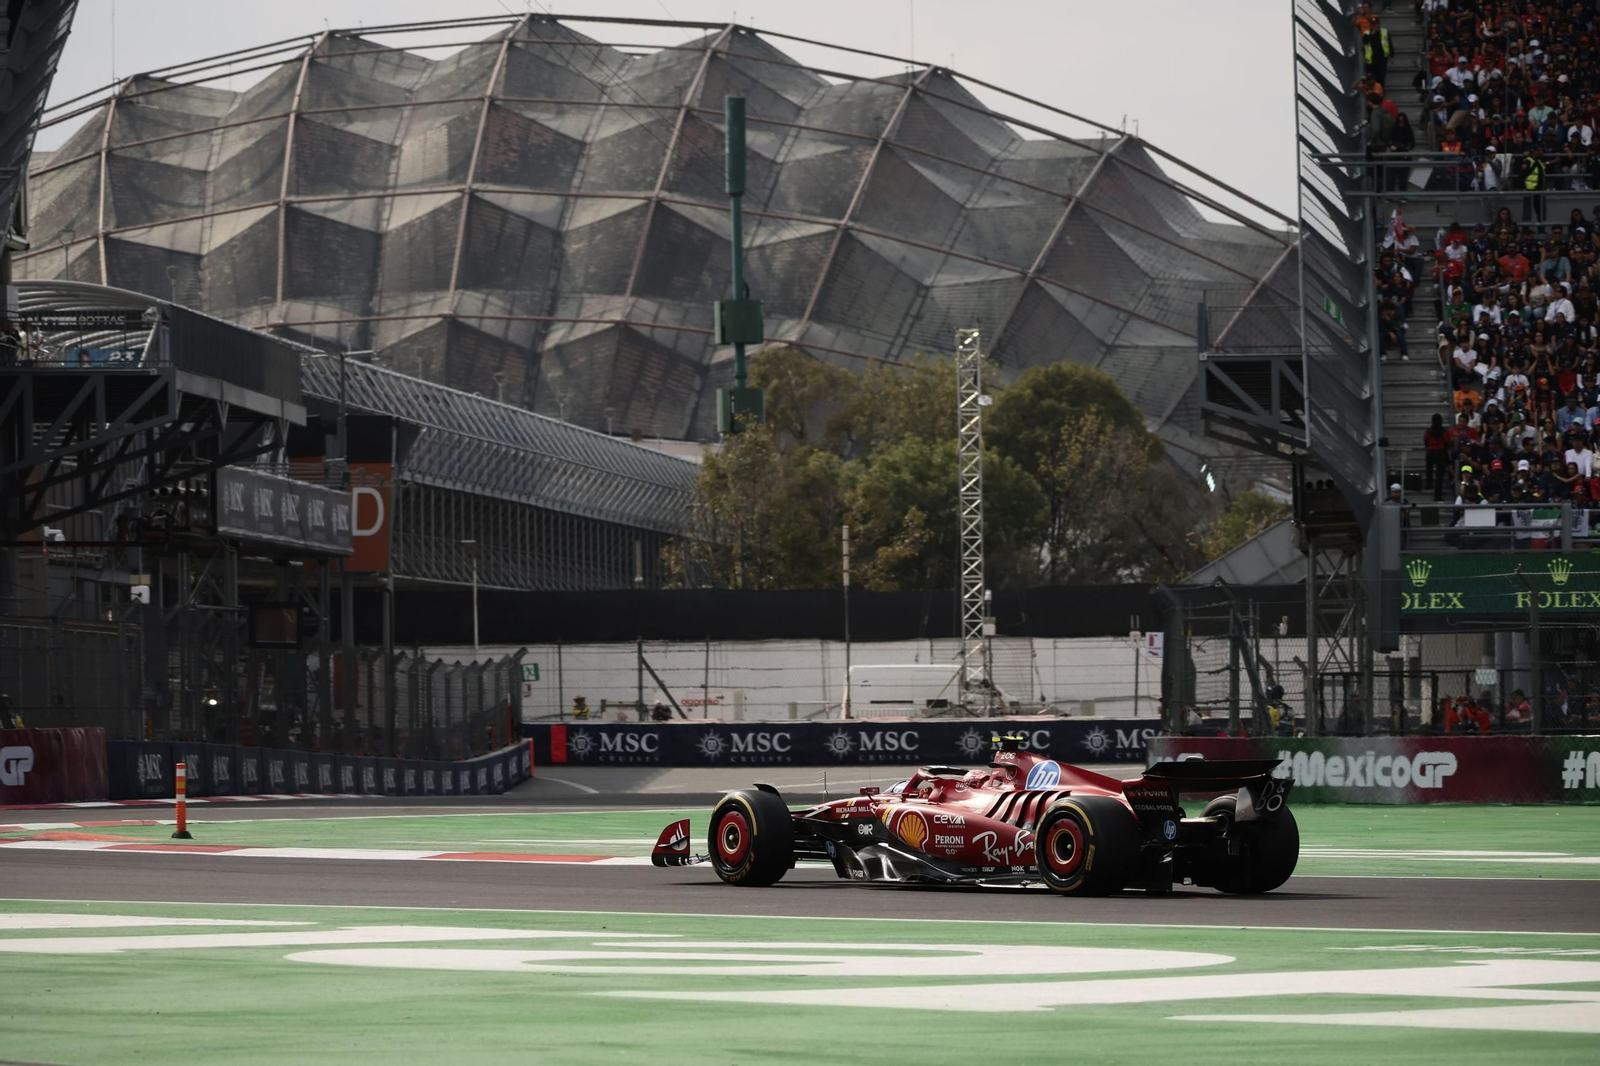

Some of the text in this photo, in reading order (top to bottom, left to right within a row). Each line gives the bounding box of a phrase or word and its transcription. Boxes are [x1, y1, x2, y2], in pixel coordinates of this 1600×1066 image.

[352, 487, 384, 537] D
[599, 732, 659, 753] MSC
[730, 732, 791, 753] MSC
[859, 731, 919, 751] MSC
[730, 755, 792, 763] CRUISES
[1271, 750, 1458, 789] #MexicoGP
[1028, 761, 1058, 789] hp
[935, 834, 964, 844] PERONI
